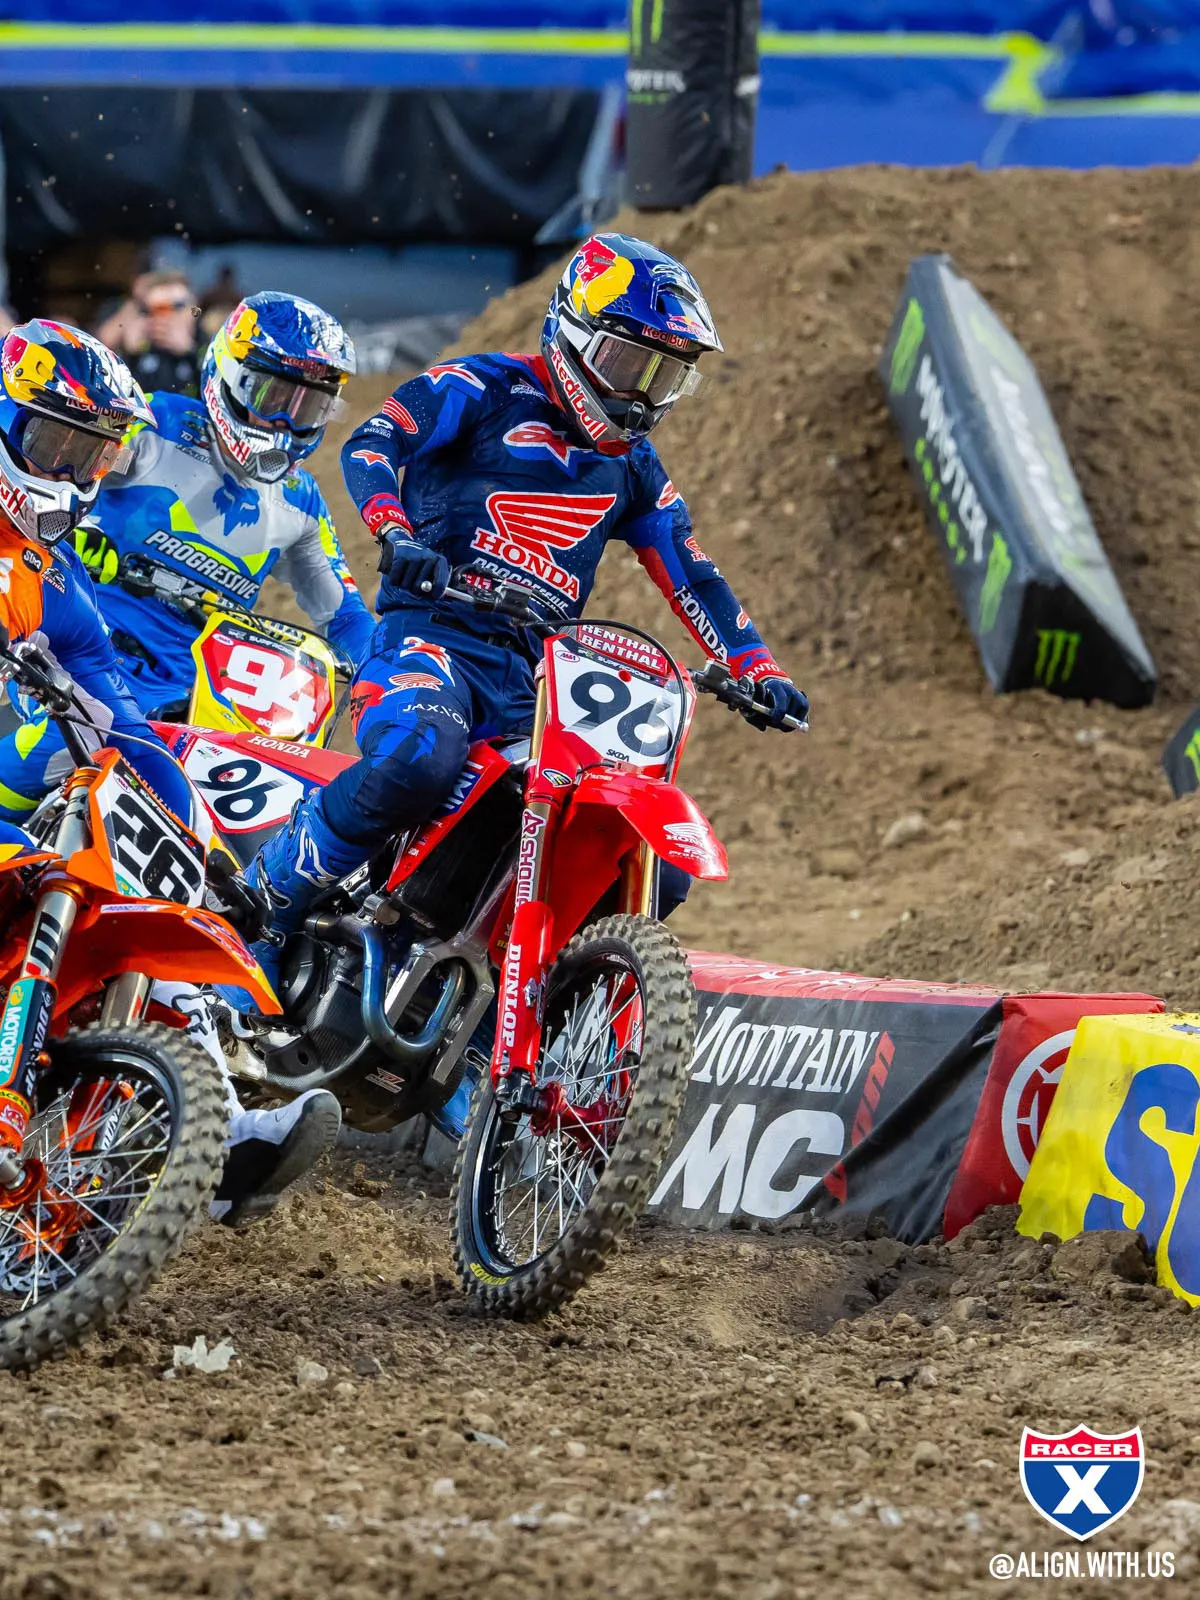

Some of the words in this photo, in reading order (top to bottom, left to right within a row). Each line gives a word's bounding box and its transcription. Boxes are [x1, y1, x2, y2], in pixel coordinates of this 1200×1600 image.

[667, 331, 688, 349] Bull
[551, 349, 580, 400] Red
[572, 394, 608, 440] Bull
[146, 529, 261, 599] PROGRESSIVE
[470, 527, 580, 602] HONDA
[580, 634, 662, 671] RENTHAL
[581, 624, 662, 657] RENTHAL
[673, 584, 729, 662] HONDA
[221, 644, 318, 731] 94
[562, 671, 673, 757] 96
[248, 734, 311, 758] HONDA
[194, 758, 288, 822] 96
[102, 793, 202, 906] 26
[502, 943, 522, 1048] DUNLOP
[689, 1005, 881, 1095] MOUNTAIN
[651, 1103, 846, 1219] MC
